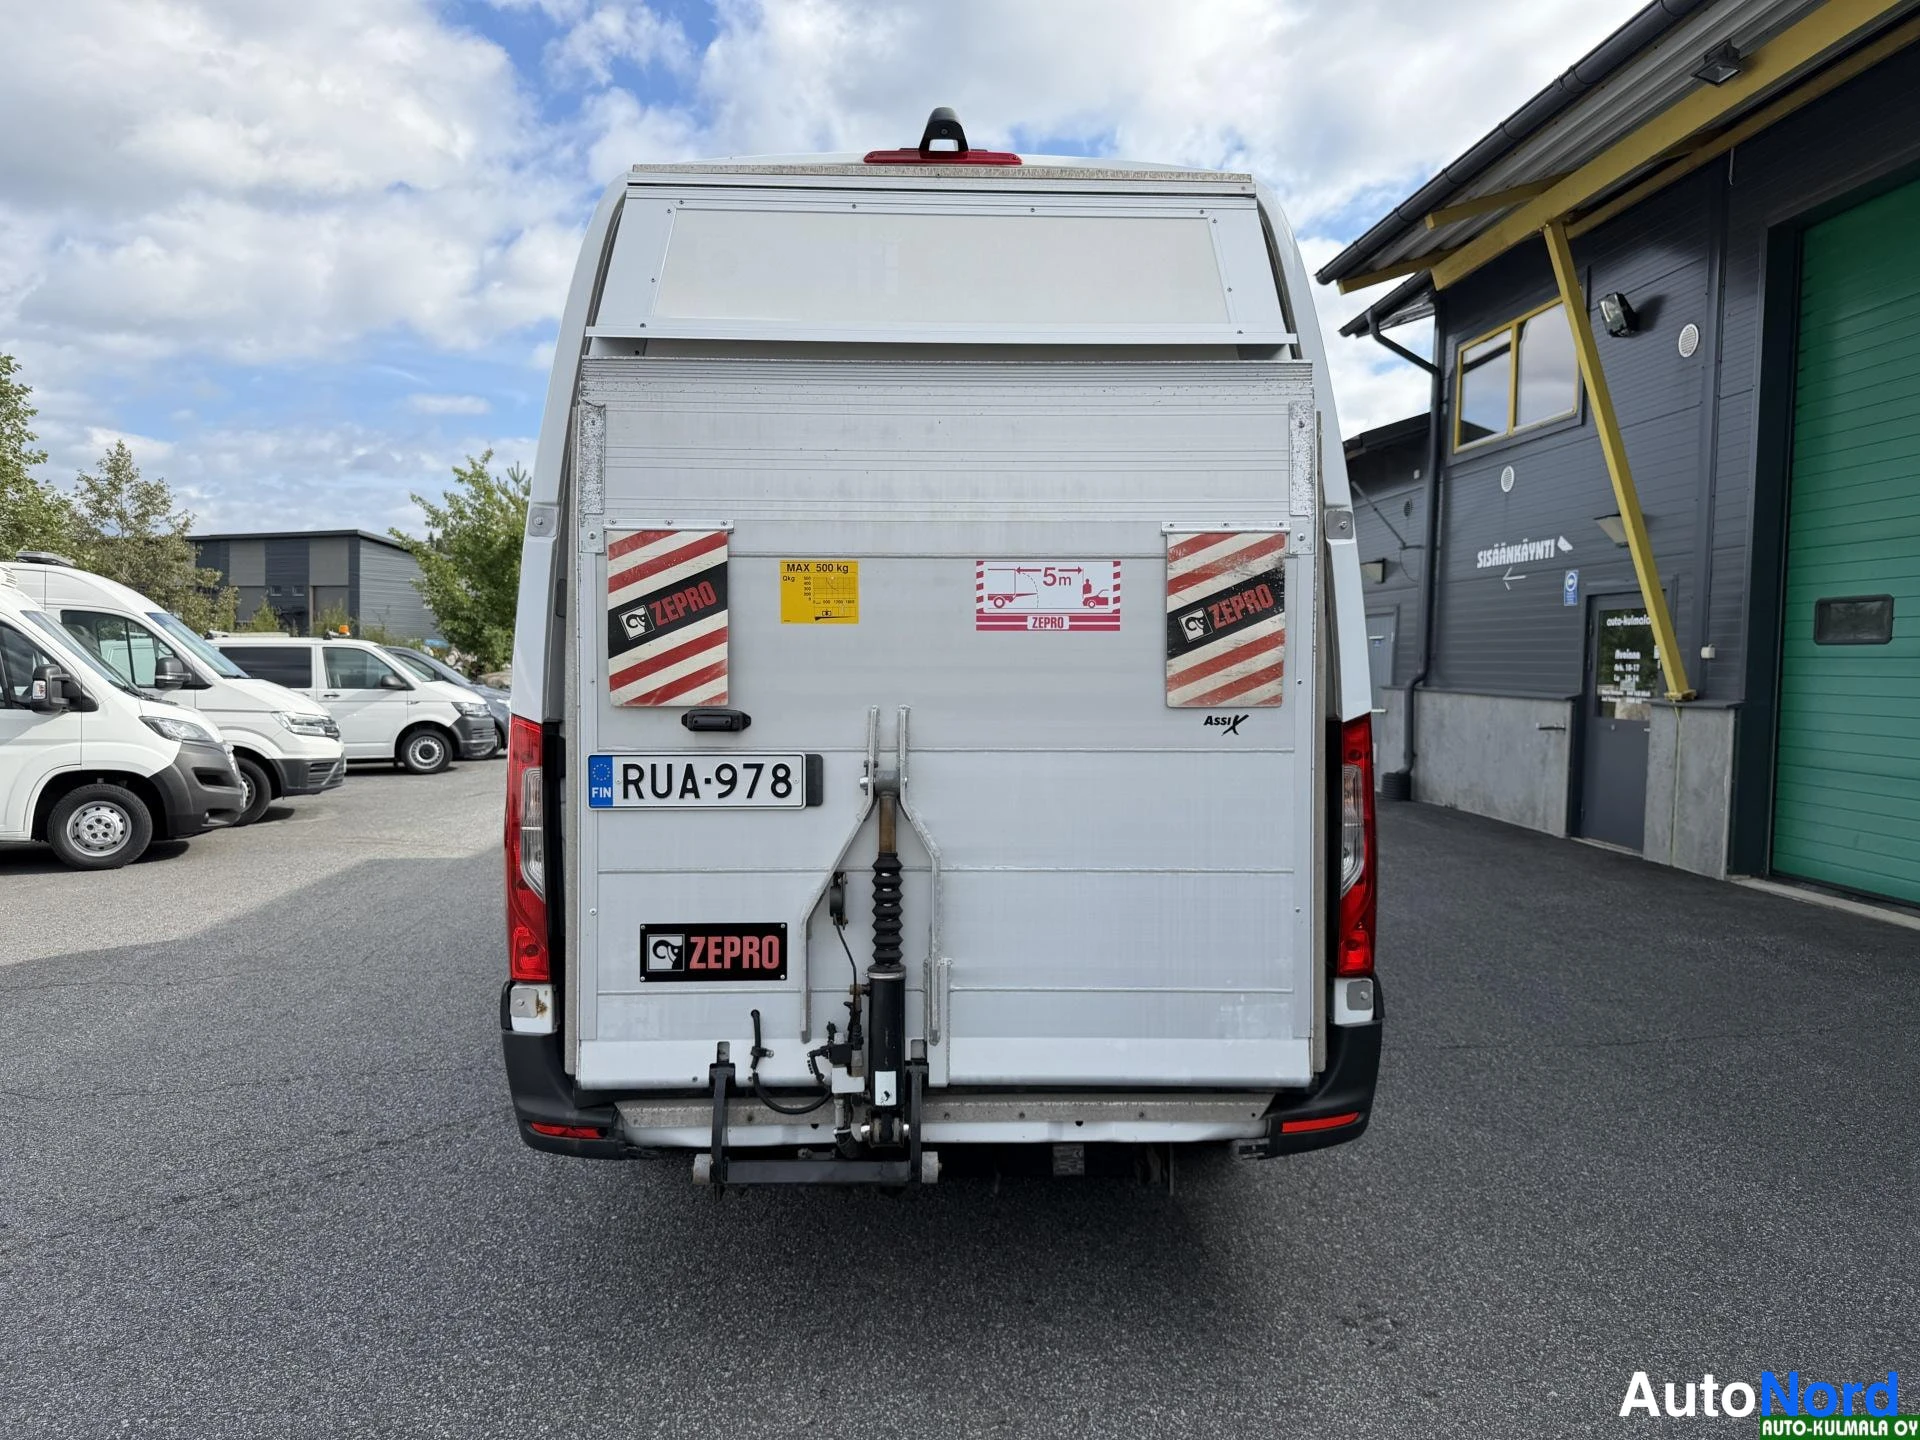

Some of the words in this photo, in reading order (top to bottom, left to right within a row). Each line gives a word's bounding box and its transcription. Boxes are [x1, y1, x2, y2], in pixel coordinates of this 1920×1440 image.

[786, 563, 810, 572] MAX
[816, 563, 833, 572] 500
[837, 563, 849, 574] kg
[1476, 538, 1555, 568] SISÄÄNKÄYNTI
[649, 581, 718, 626] ZEPRO
[1208, 583, 1275, 629] ZEPRO
[1032, 616, 1064, 629] ZEPRO
[591, 786, 612, 799] FIN
[622, 762, 793, 800] RUA-978
[689, 935, 780, 970] ZEPRO
